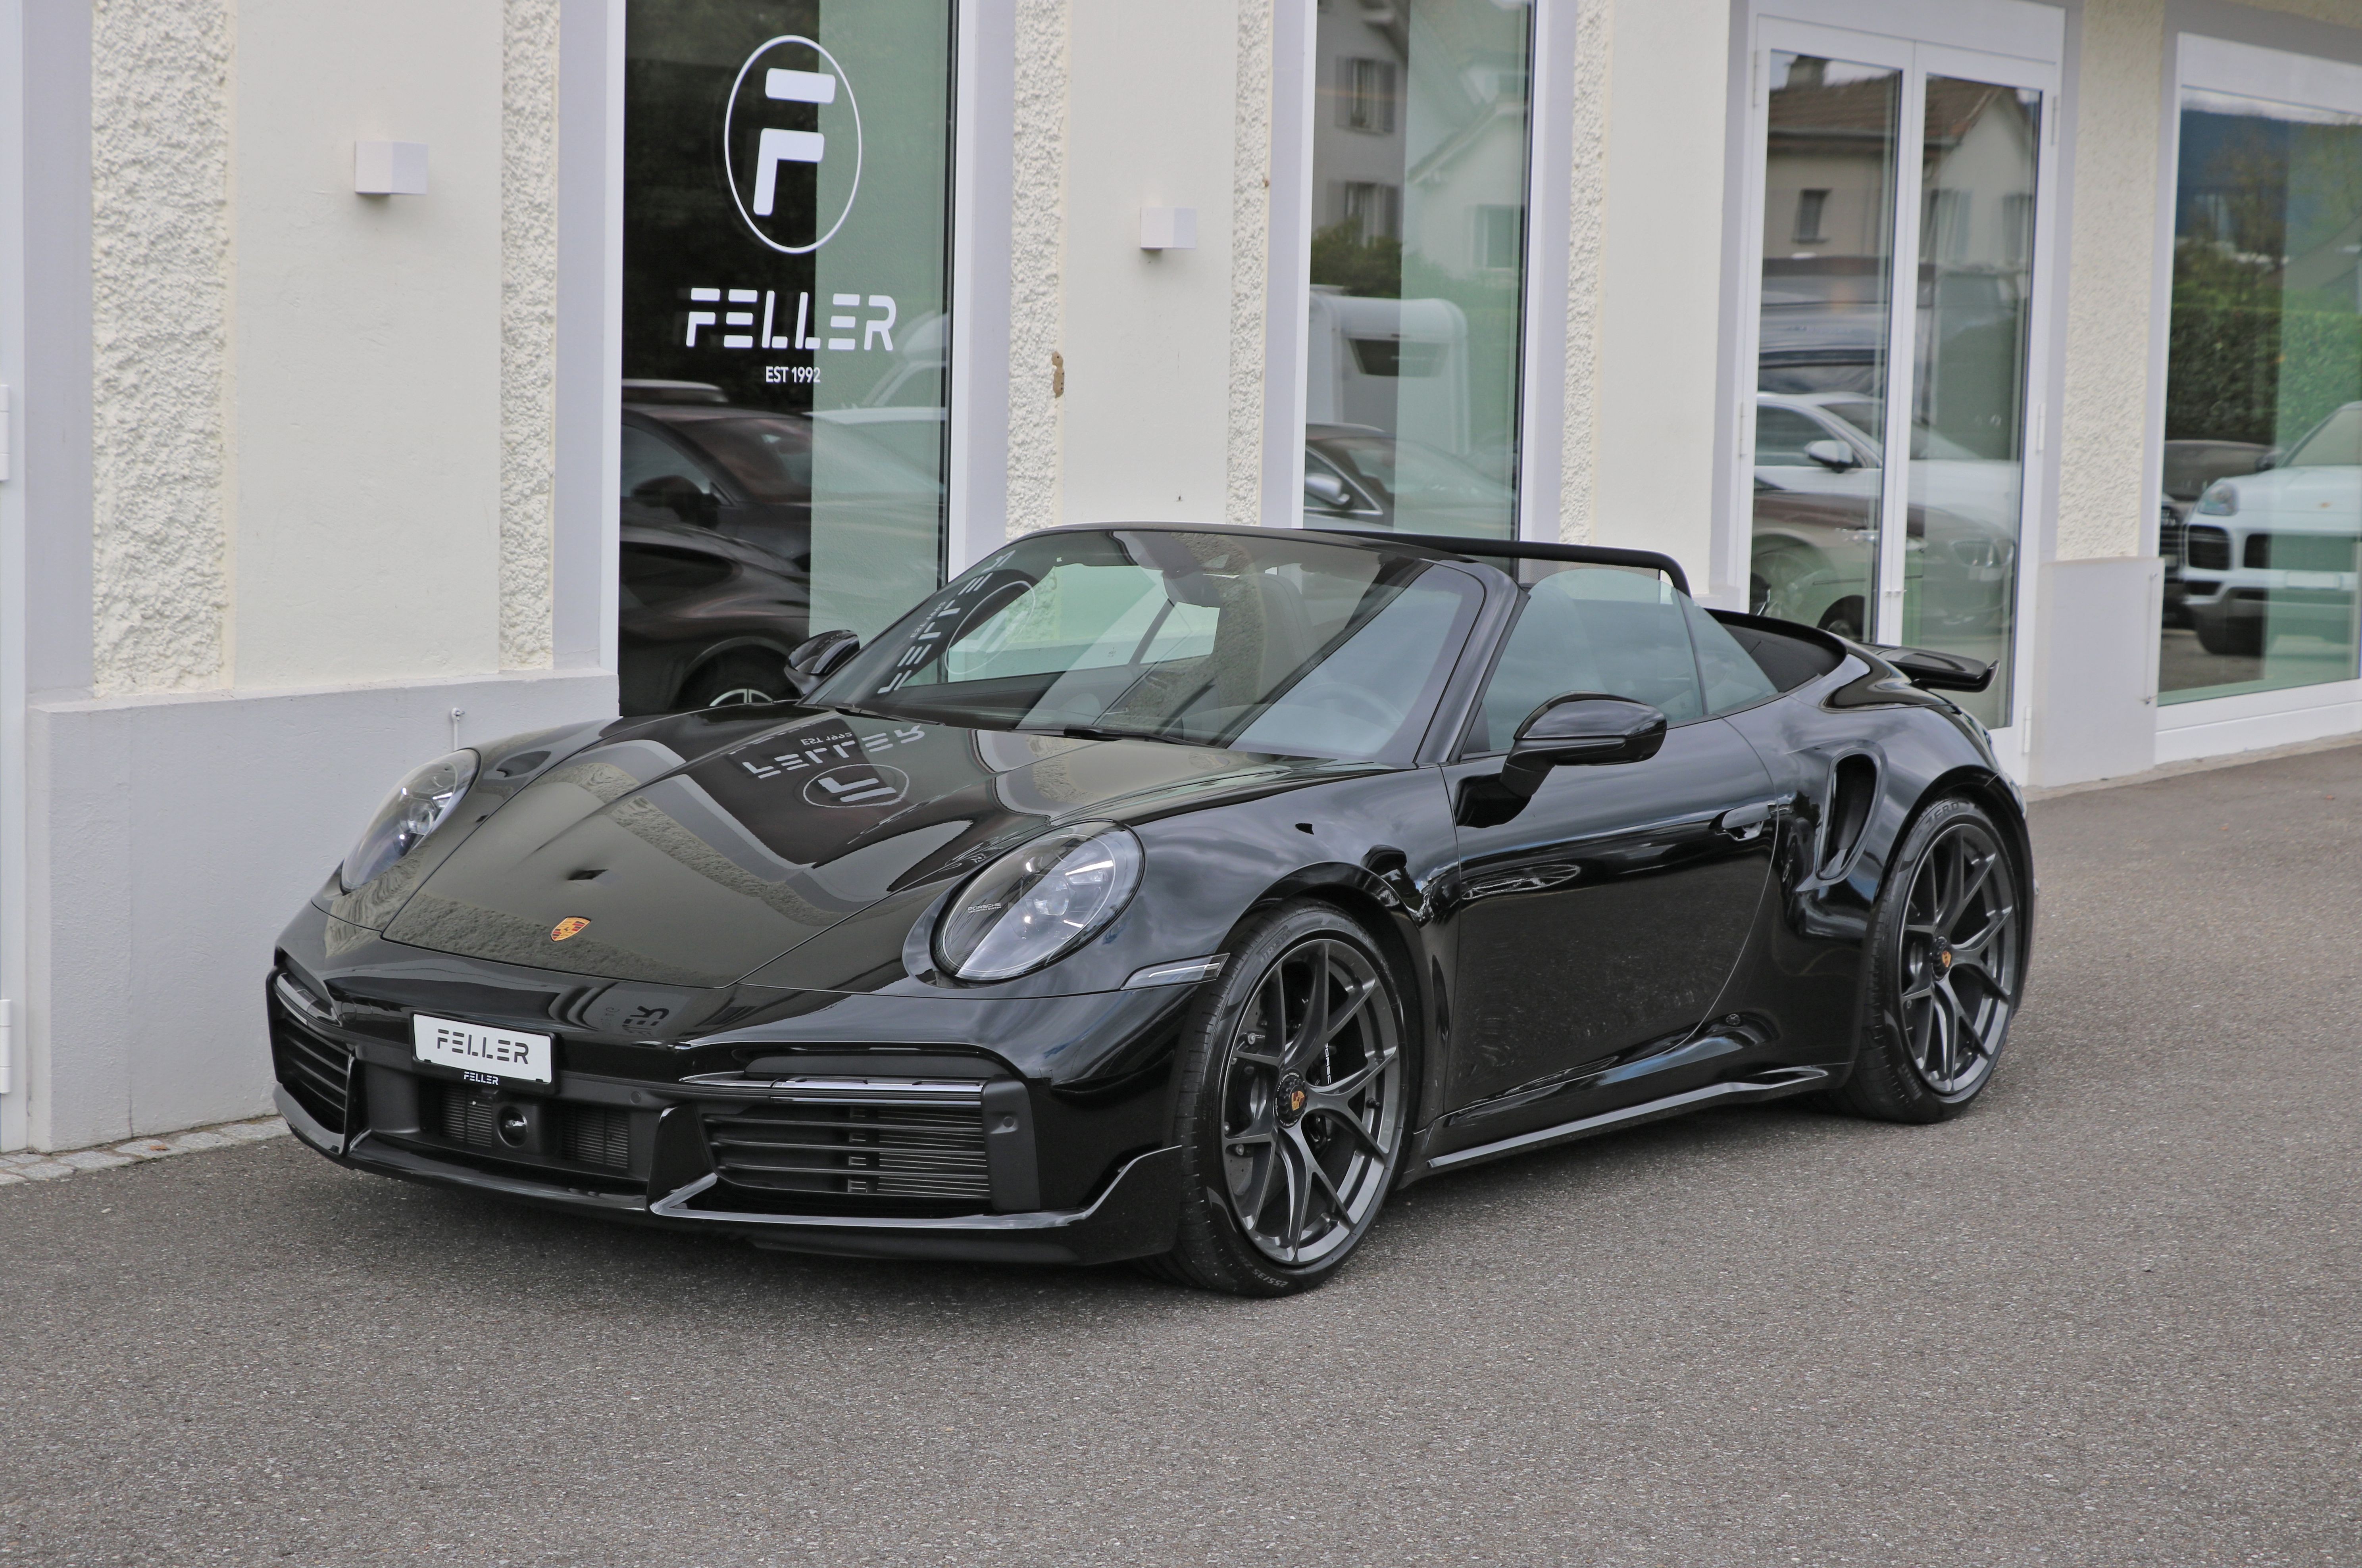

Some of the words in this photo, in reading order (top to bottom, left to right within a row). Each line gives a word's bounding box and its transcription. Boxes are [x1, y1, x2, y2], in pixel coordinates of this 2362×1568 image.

[753, 67, 836, 216] F
[686, 287, 896, 351] FELLER
[766, 366, 789, 383] EST
[791, 366, 821, 383] 1992
[967, 902, 1001, 911] PORSCHE
[437, 1029, 529, 1064] FELLER
[463, 1071, 498, 1086] FELLER
[1251, 1268, 1289, 1287] 255/35
